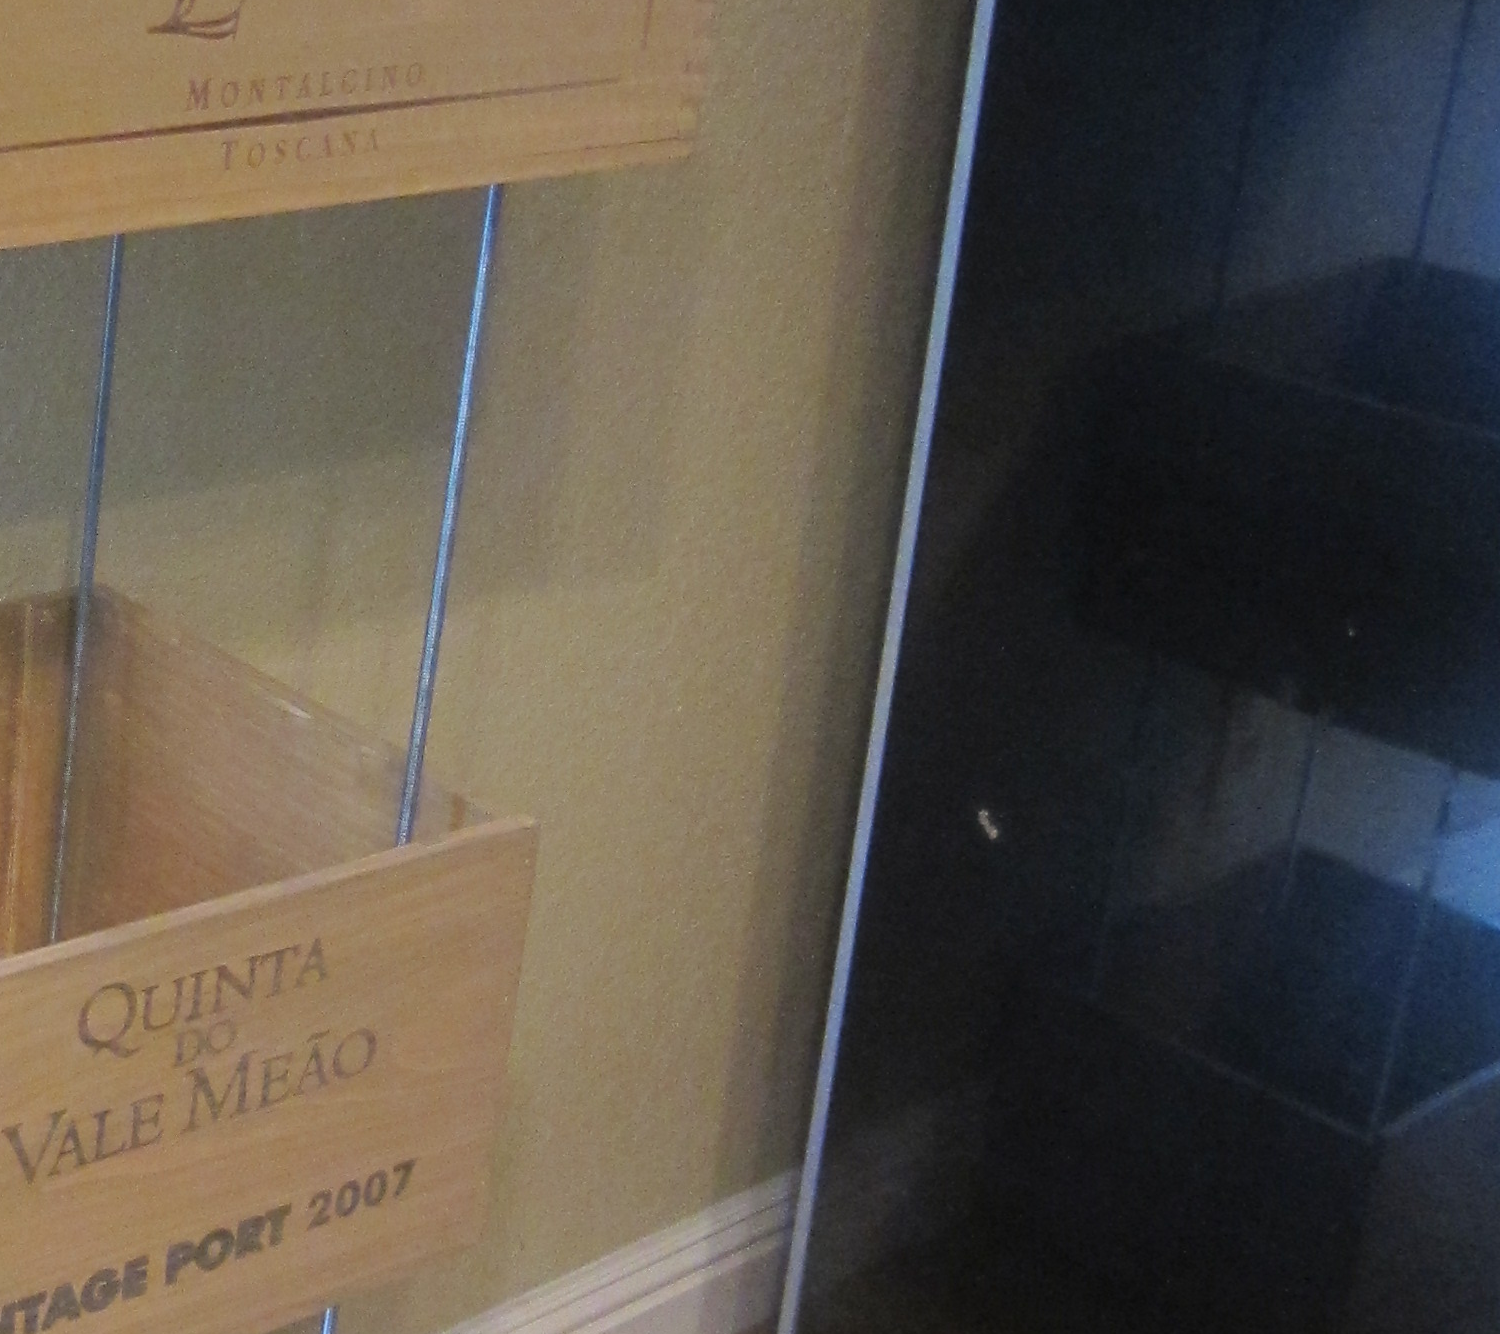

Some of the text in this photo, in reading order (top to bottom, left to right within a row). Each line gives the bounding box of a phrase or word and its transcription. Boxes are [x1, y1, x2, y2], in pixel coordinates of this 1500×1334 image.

[184, 61, 426, 114] MONTALCINO
[220, 127, 382, 171] TOSCANA
[76, 936, 330, 1059] QUINTA
[172, 1017, 238, 1068] DO
[0, 1027, 379, 1187] VALE MEÃO
[164, 1202, 293, 1287] PORT
[306, 1158, 418, 1231] 2007
